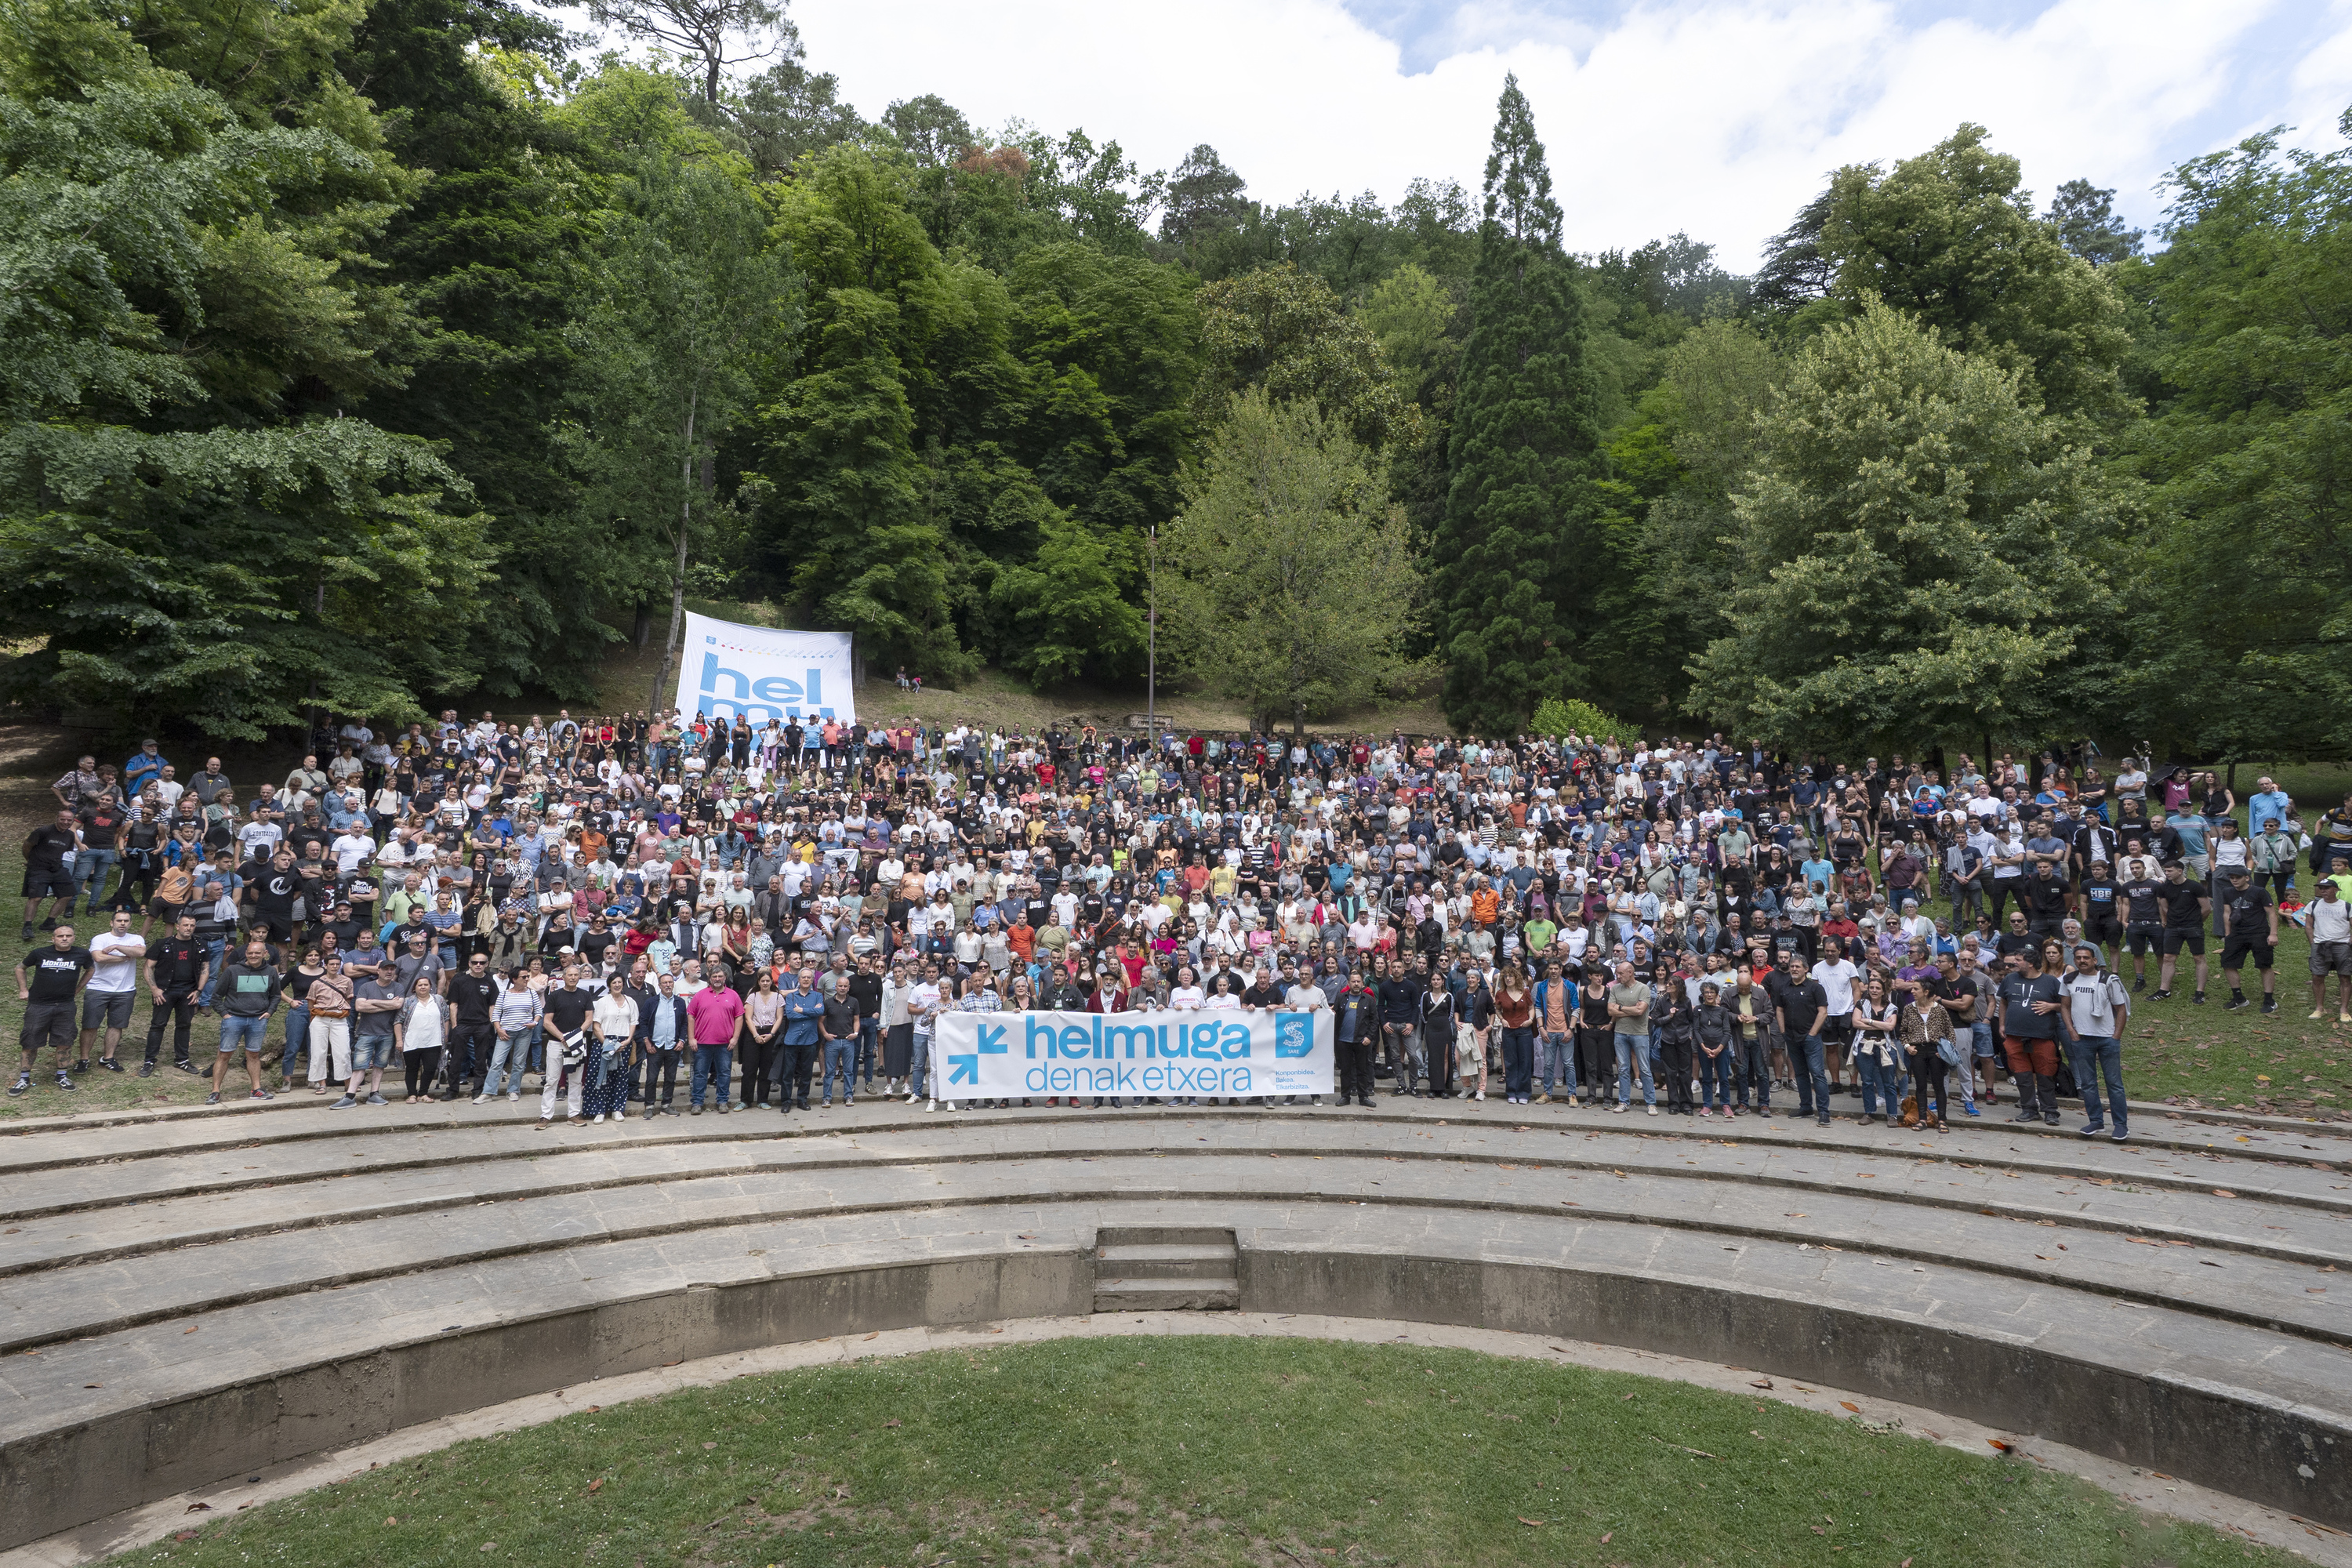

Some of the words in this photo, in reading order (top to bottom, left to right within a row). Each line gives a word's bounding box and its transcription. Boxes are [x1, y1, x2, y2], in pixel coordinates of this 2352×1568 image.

[700, 652, 822, 704] hel
[42, 959, 75, 968] MONDRA
[1025, 1015, 1251, 1062] helmuga
[1025, 1062, 1137, 1091] denak
[1143, 1062, 1252, 1091] etxera
